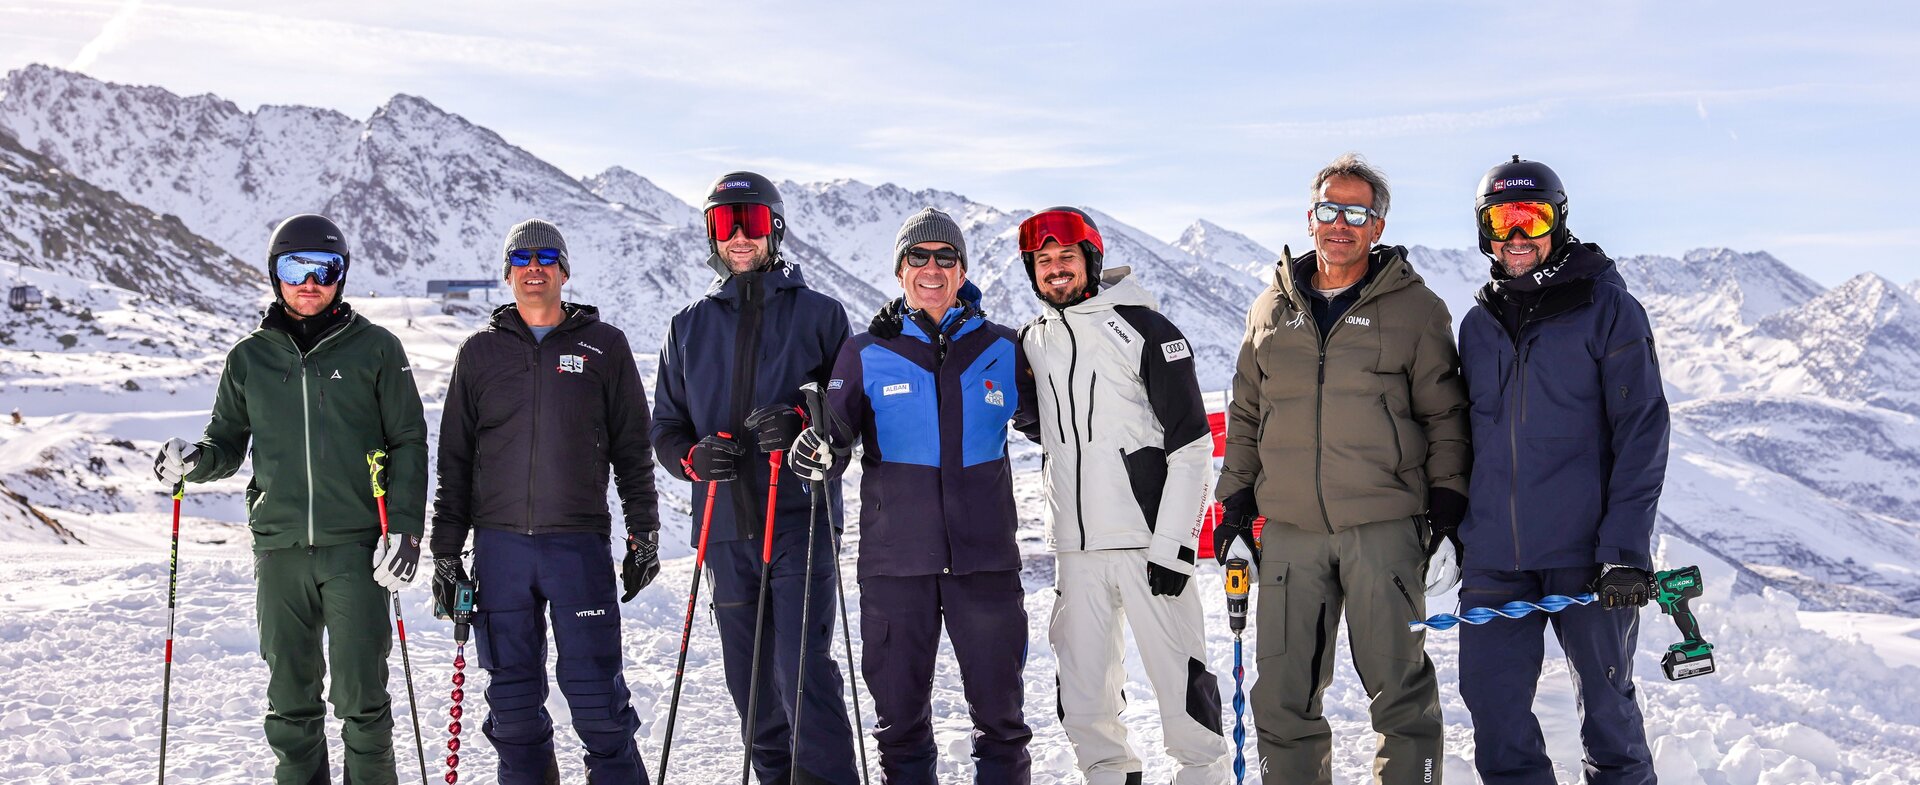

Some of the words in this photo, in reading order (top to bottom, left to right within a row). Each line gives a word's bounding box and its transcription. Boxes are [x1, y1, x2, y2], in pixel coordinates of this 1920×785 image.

[1506, 179, 1534, 187] GURGL
[1344, 315, 1371, 326] COLMAR
[885, 384, 907, 393] ALBAN
[575, 609, 606, 618] VITALINI
[1424, 758, 1433, 784] COLMAR
